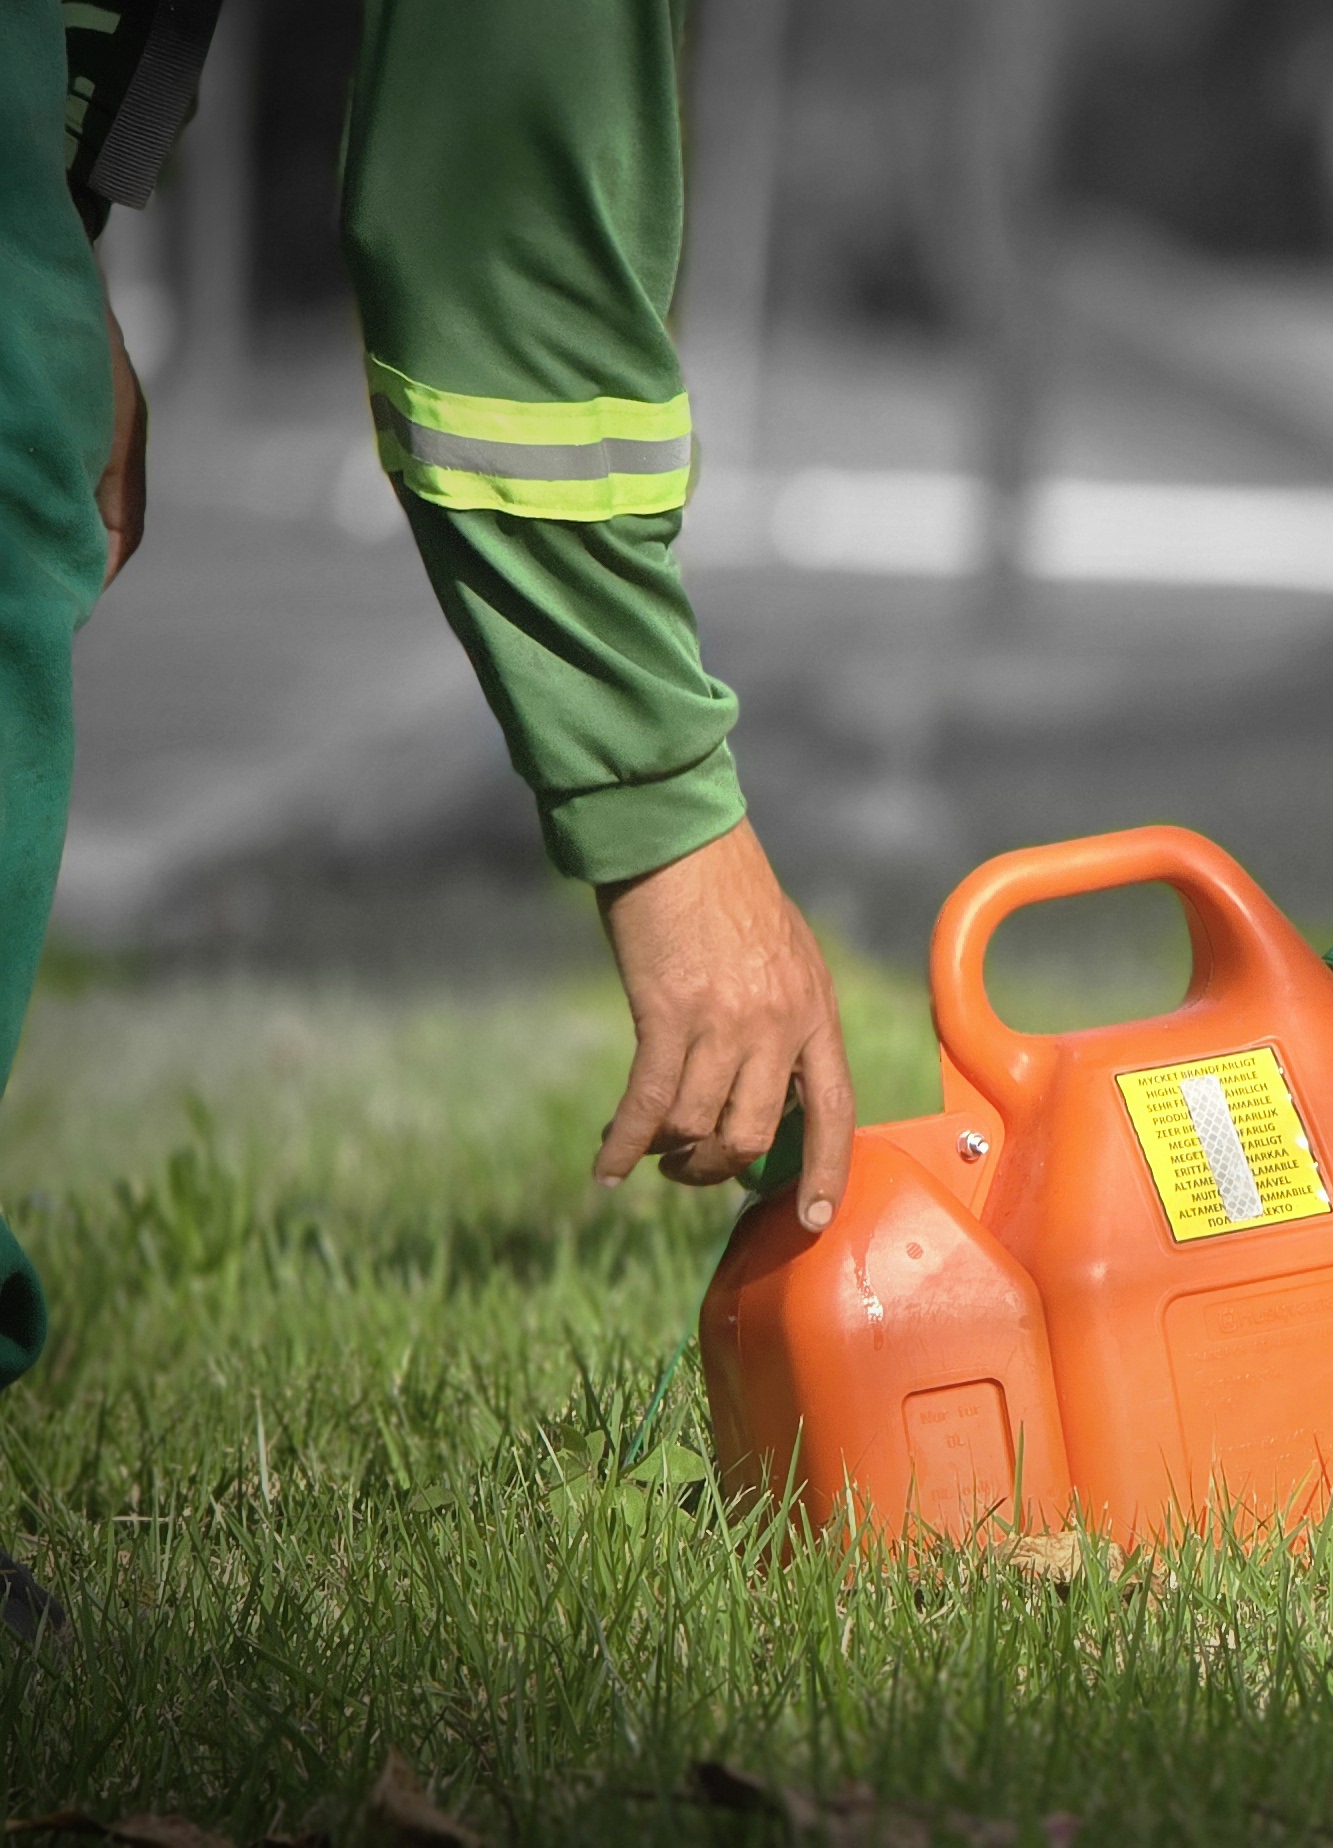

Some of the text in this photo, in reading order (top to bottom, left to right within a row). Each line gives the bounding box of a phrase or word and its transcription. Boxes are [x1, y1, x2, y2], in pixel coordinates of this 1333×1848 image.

[1138, 1058, 1256, 1087] MYCKET BRANDFARLIGT
[1146, 1101, 1173, 1113] SEHR
[1152, 1112, 1190, 1126] PRODU
[1156, 1128, 1181, 1139] ZEER
[1168, 1137, 1202, 1151] MEGET
[1170, 1150, 1205, 1164] MEGET
[1174, 1161, 1210, 1178] ERITTÄ
[1174, 1176, 1216, 1192] ALTAME
[1191, 1188, 1221, 1203] MUIT
[1179, 1202, 1227, 1219] ALTAMEN
